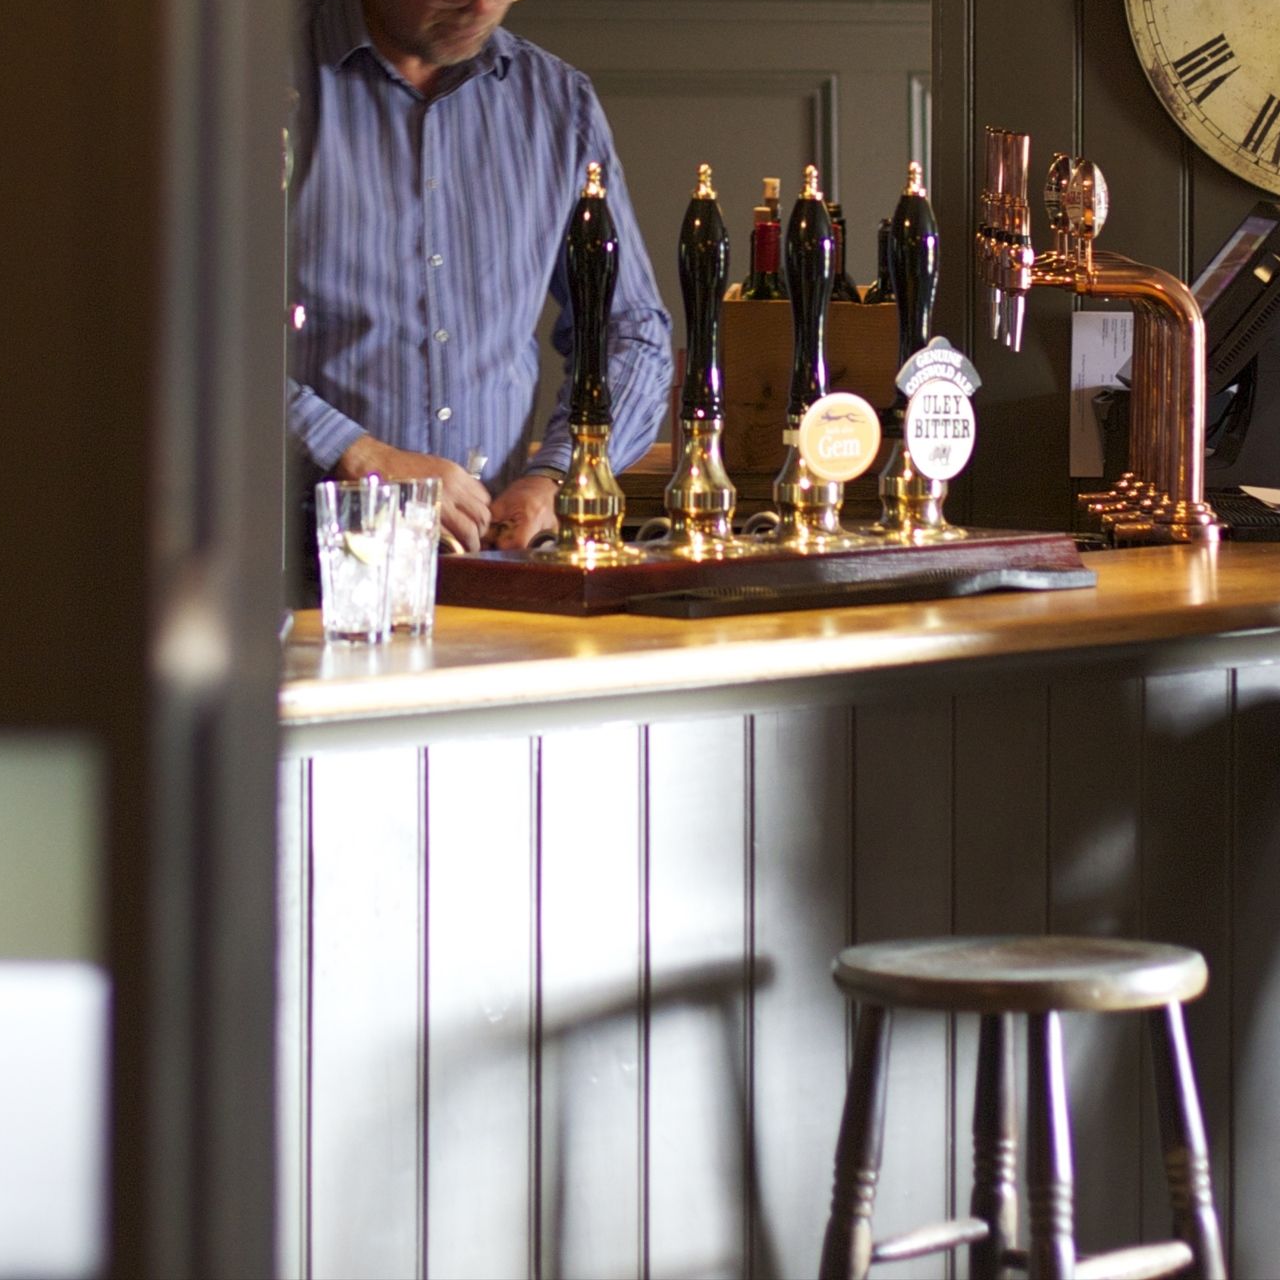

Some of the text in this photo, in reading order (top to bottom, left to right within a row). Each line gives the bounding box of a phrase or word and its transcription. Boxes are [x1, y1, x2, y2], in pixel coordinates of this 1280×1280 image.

[916, 348, 963, 368] GENUINE
[922, 394, 963, 415] ULEY
[914, 418, 971, 439] BITTER
[817, 434, 861, 460] Gem
